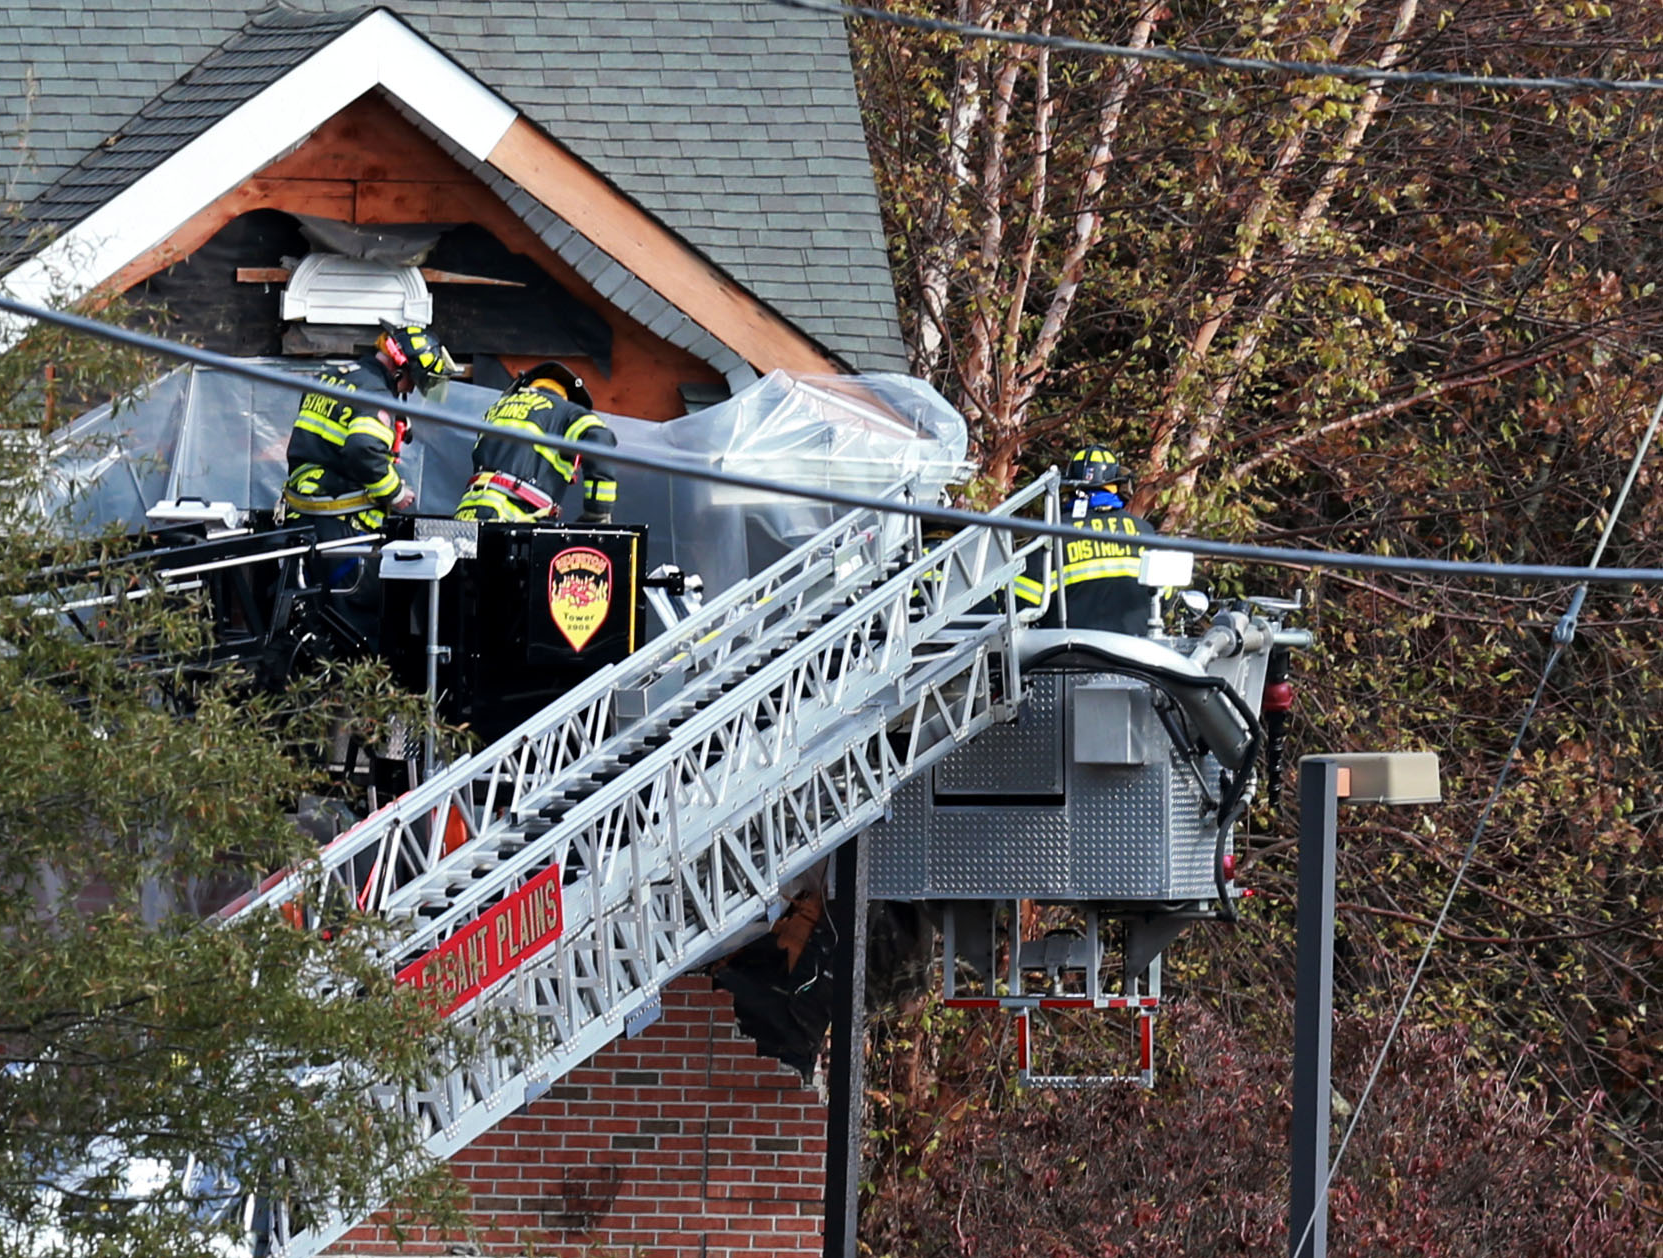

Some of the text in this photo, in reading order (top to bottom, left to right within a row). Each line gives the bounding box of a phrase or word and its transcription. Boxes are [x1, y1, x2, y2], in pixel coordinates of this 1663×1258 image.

[338, 406, 353, 427] 2
[563, 612, 595, 621] Tower
[397, 879, 557, 1014] EASANT PLAINS
